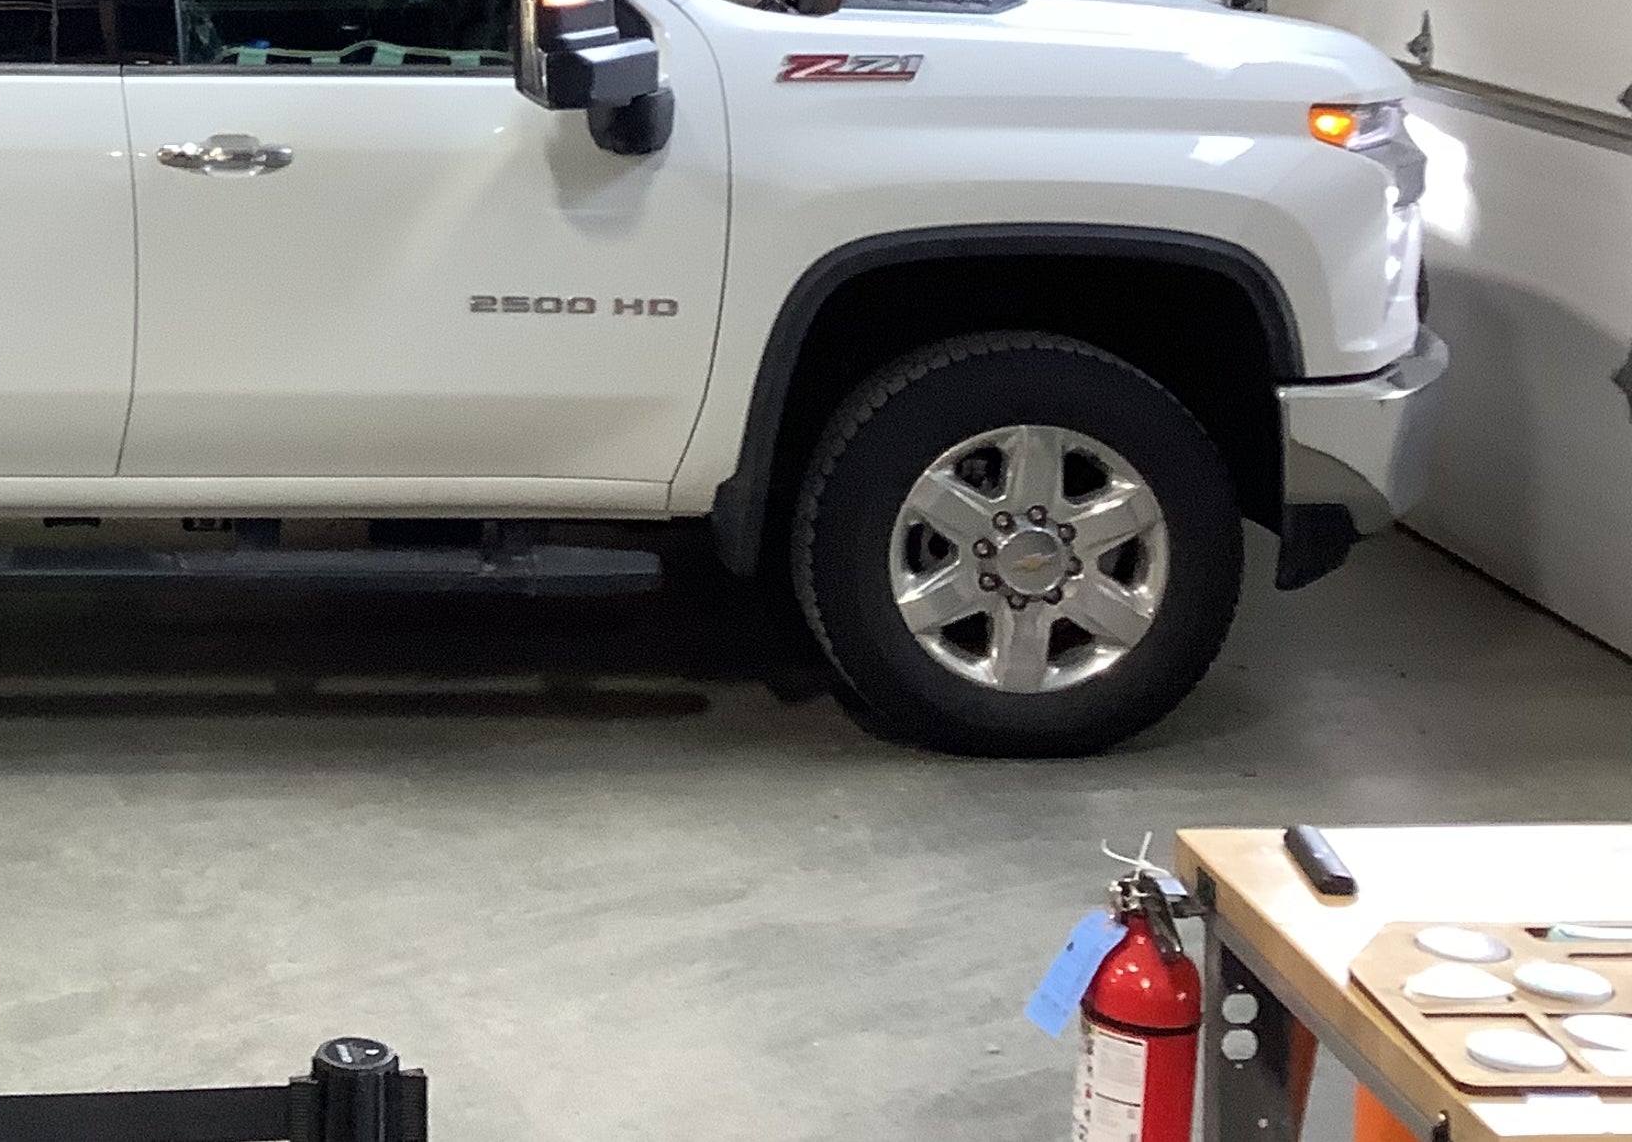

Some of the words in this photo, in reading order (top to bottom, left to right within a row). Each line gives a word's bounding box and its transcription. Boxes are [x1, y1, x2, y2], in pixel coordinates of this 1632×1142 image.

[777, 54, 924, 83] Z71
[469, 295, 597, 314] 2500
[612, 298, 679, 316] HD
